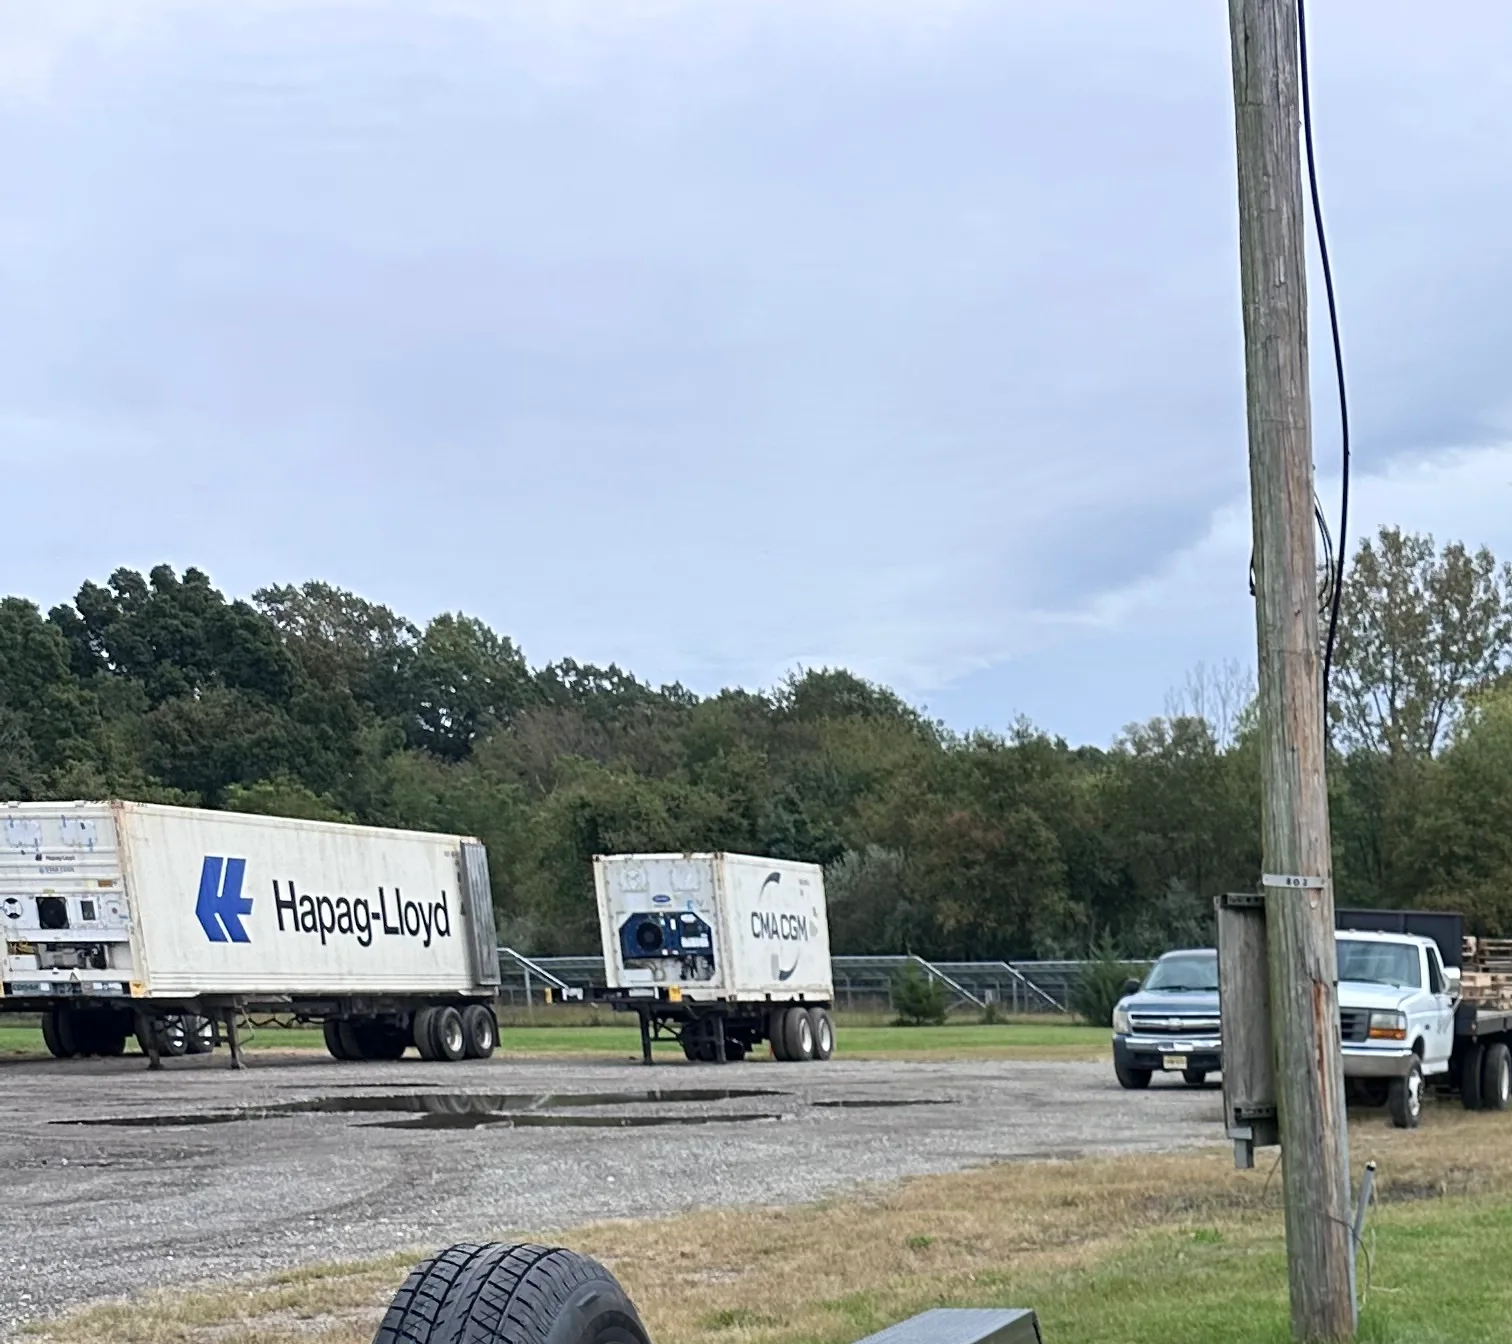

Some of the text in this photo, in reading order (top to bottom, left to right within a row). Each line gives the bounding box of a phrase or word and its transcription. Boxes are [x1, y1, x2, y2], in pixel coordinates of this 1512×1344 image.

[272, 879, 451, 948] Hapag-Lloyd
[751, 911, 809, 942] CMA CGM
